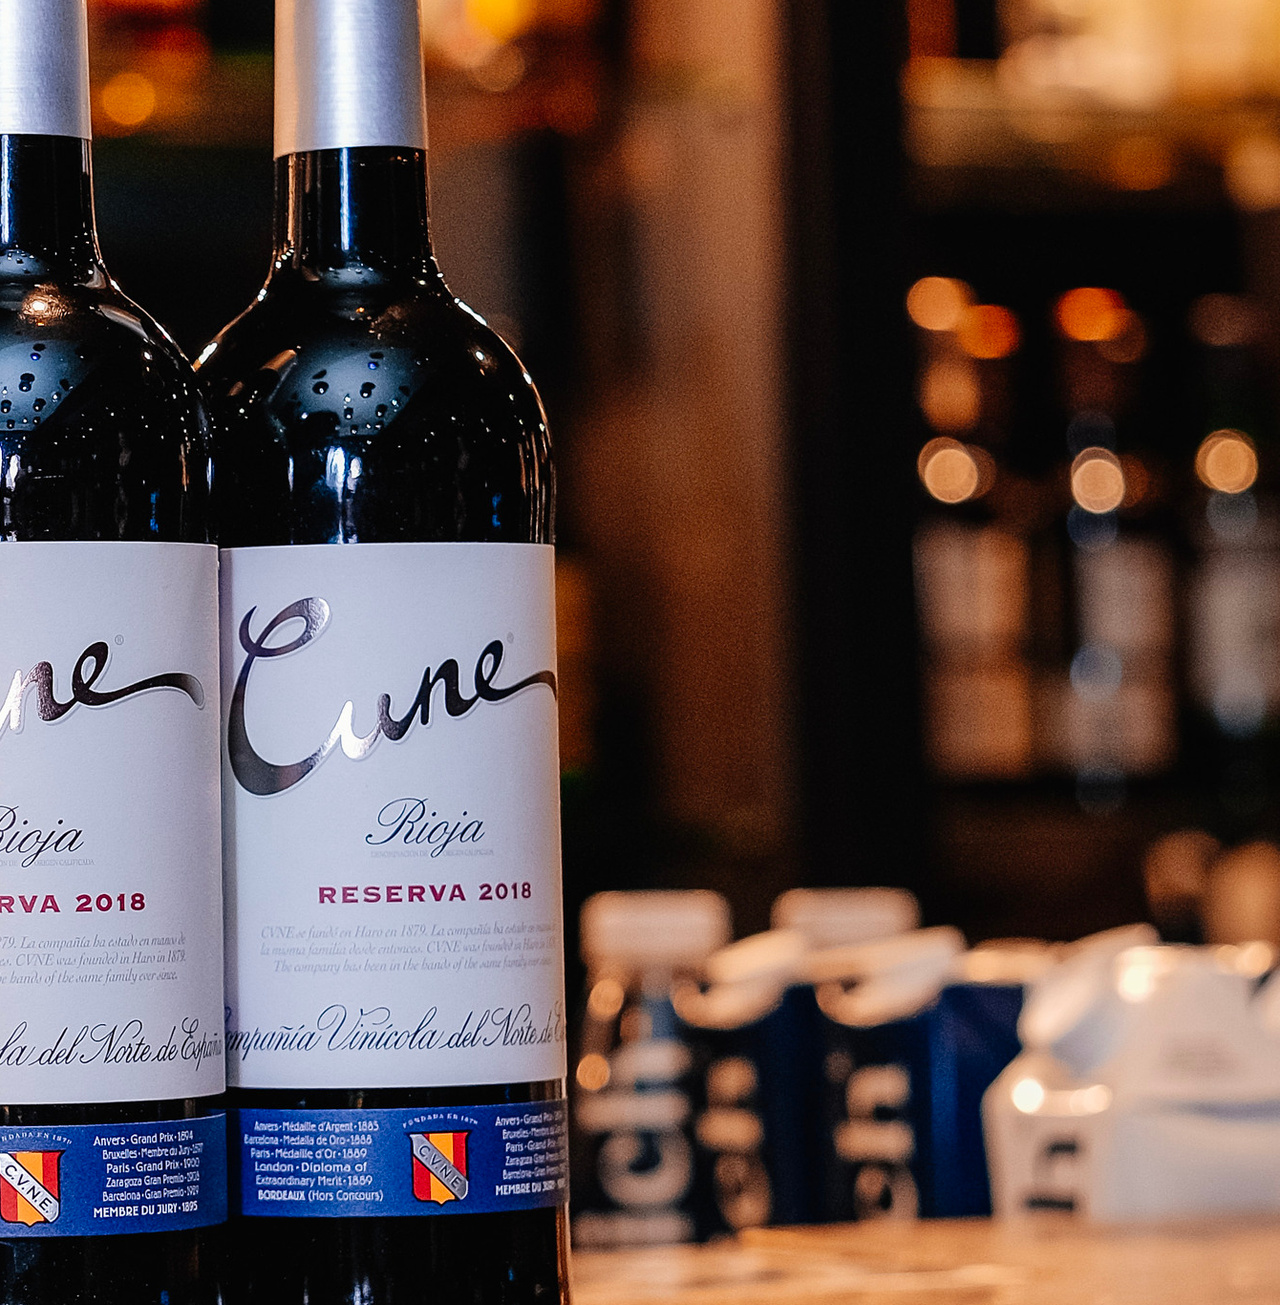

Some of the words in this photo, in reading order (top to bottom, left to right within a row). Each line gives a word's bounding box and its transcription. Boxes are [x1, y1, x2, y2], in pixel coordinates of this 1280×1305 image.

[228, 597, 557, 796] Cune
[365, 797, 485, 858] Rioja
[75, 892, 146, 912] 2018
[319, 884, 466, 904] RESERVA
[478, 882, 532, 901] 2018
[21, 936, 36, 949] La
[16, 954, 54, 966] CVNE
[77, 952, 118, 968] founded
[10, 971, 42, 984] hands
[45, 970, 57, 987] of
[58, 971, 74, 983] the
[104, 968, 138, 986] family
[224, 1007, 321, 1061] ompañía
[317, 1004, 443, 1052] Vinícola
[437, 1011, 485, 1049] del
[483, 1003, 537, 1046] Norte
[29, 1026, 85, 1066] del
[81, 1019, 151, 1066] Norte
[151, 1026, 178, 1061] de
[131, 1134, 157, 1145] Grand
[107, 1163, 130, 1174] Paris
[136, 1161, 163, 1172] Grand
[255, 1162, 294, 1172] London
[302, 1162, 351, 1173] Diploma
[355, 1162, 367, 1172] of
[5, 1165, 53, 1213] C.V.N.E.
[258, 1190, 306, 1201] BORDEAUX
[308, 1190, 333, 1202] (Hors
[336, 1190, 384, 1202] Concours)
[94, 1205, 139, 1218] MEMBRE
[142, 1204, 155, 1215] DU
[157, 1203, 178, 1214] JURY
